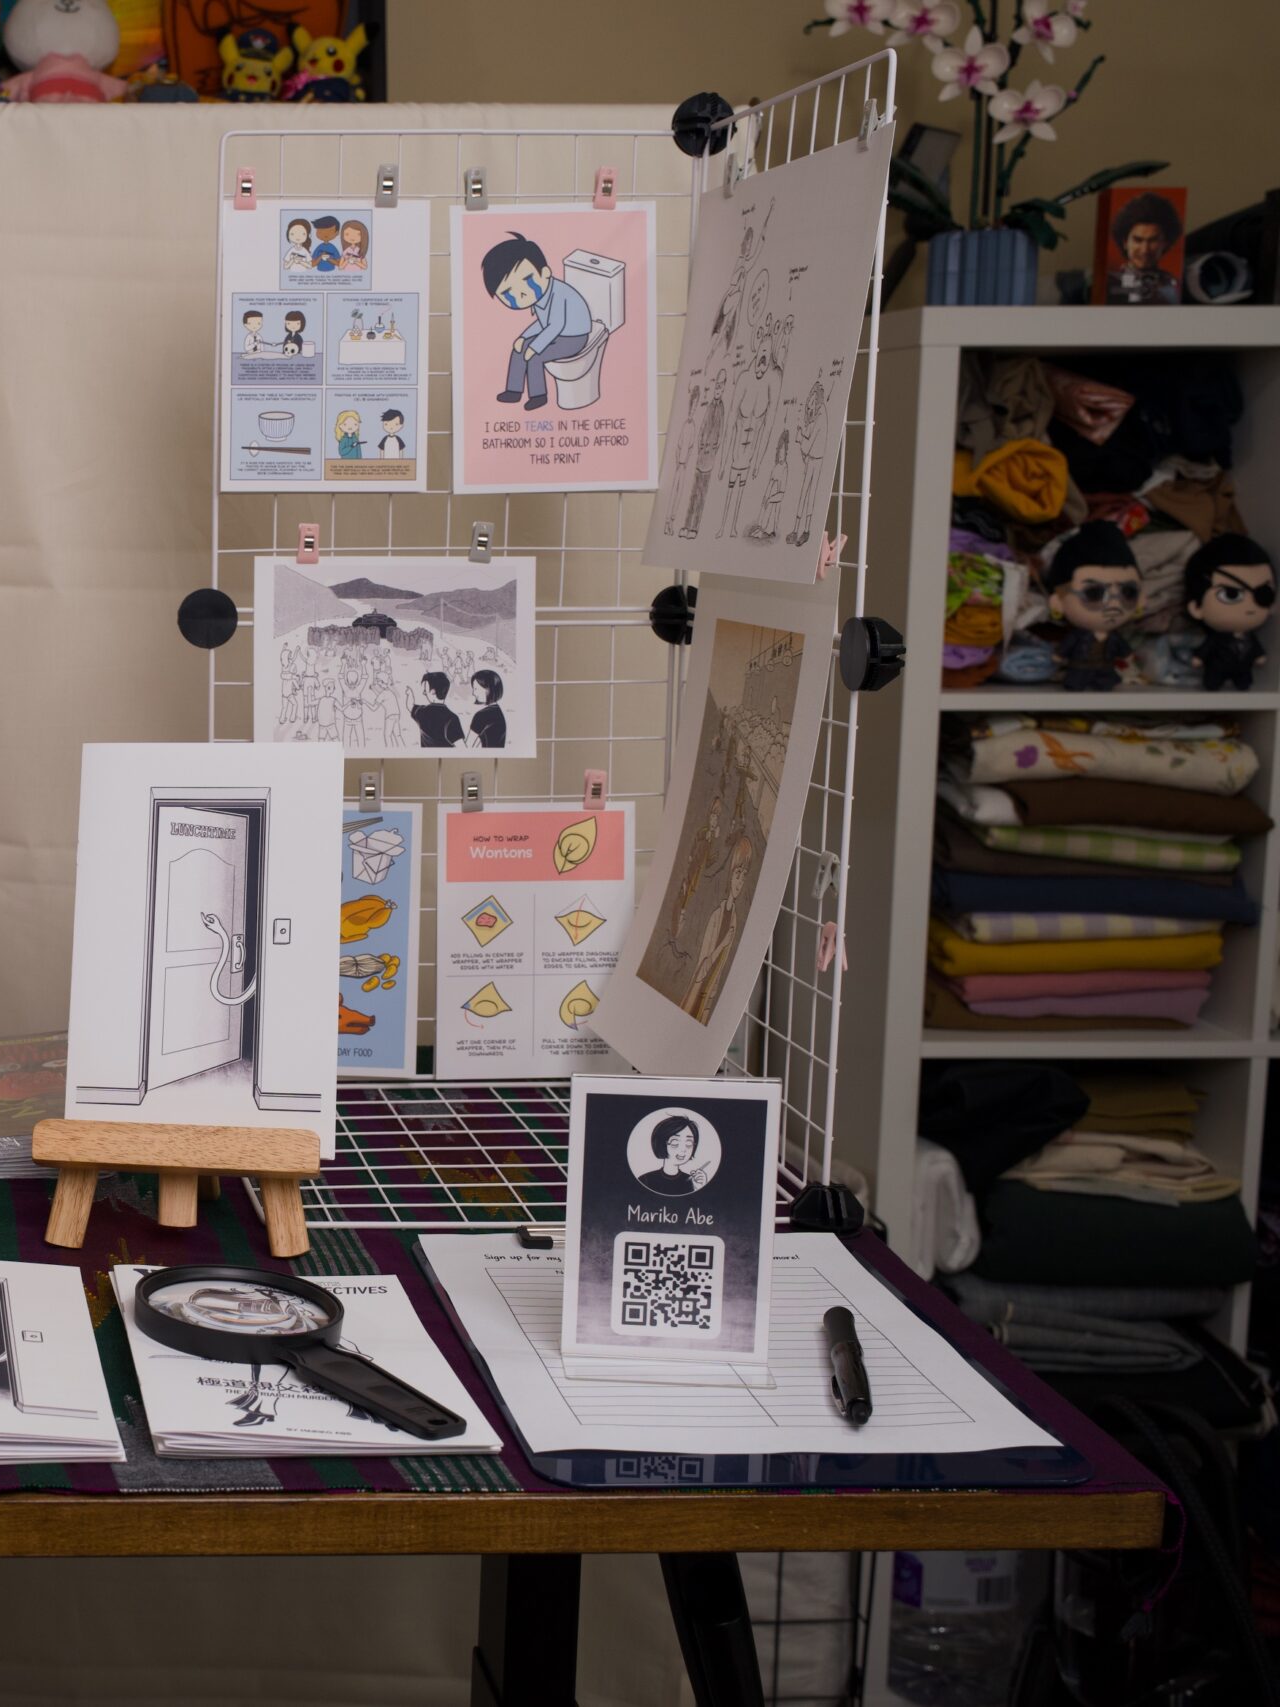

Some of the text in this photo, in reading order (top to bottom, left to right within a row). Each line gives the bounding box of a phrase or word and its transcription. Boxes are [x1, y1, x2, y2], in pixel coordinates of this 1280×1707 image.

[484, 418, 627, 433] I CRIED TEARS IN THE OFFICE
[482, 435, 629, 450] BATHROOM SO I COULD AFFORD
[529, 452, 582, 465] THIS PRINT
[170, 822, 237, 840] LUNCHTIME
[506, 834, 529, 842] WRAP
[469, 845, 533, 859] Wontons
[353, 1047, 373, 1058] FOOD
[627, 1204, 714, 1226] Mariko Abe
[483, 1253, 507, 1262] Sign
[526, 1253, 540, 1262] for
[324, 1285, 388, 1295] ECTIVES
